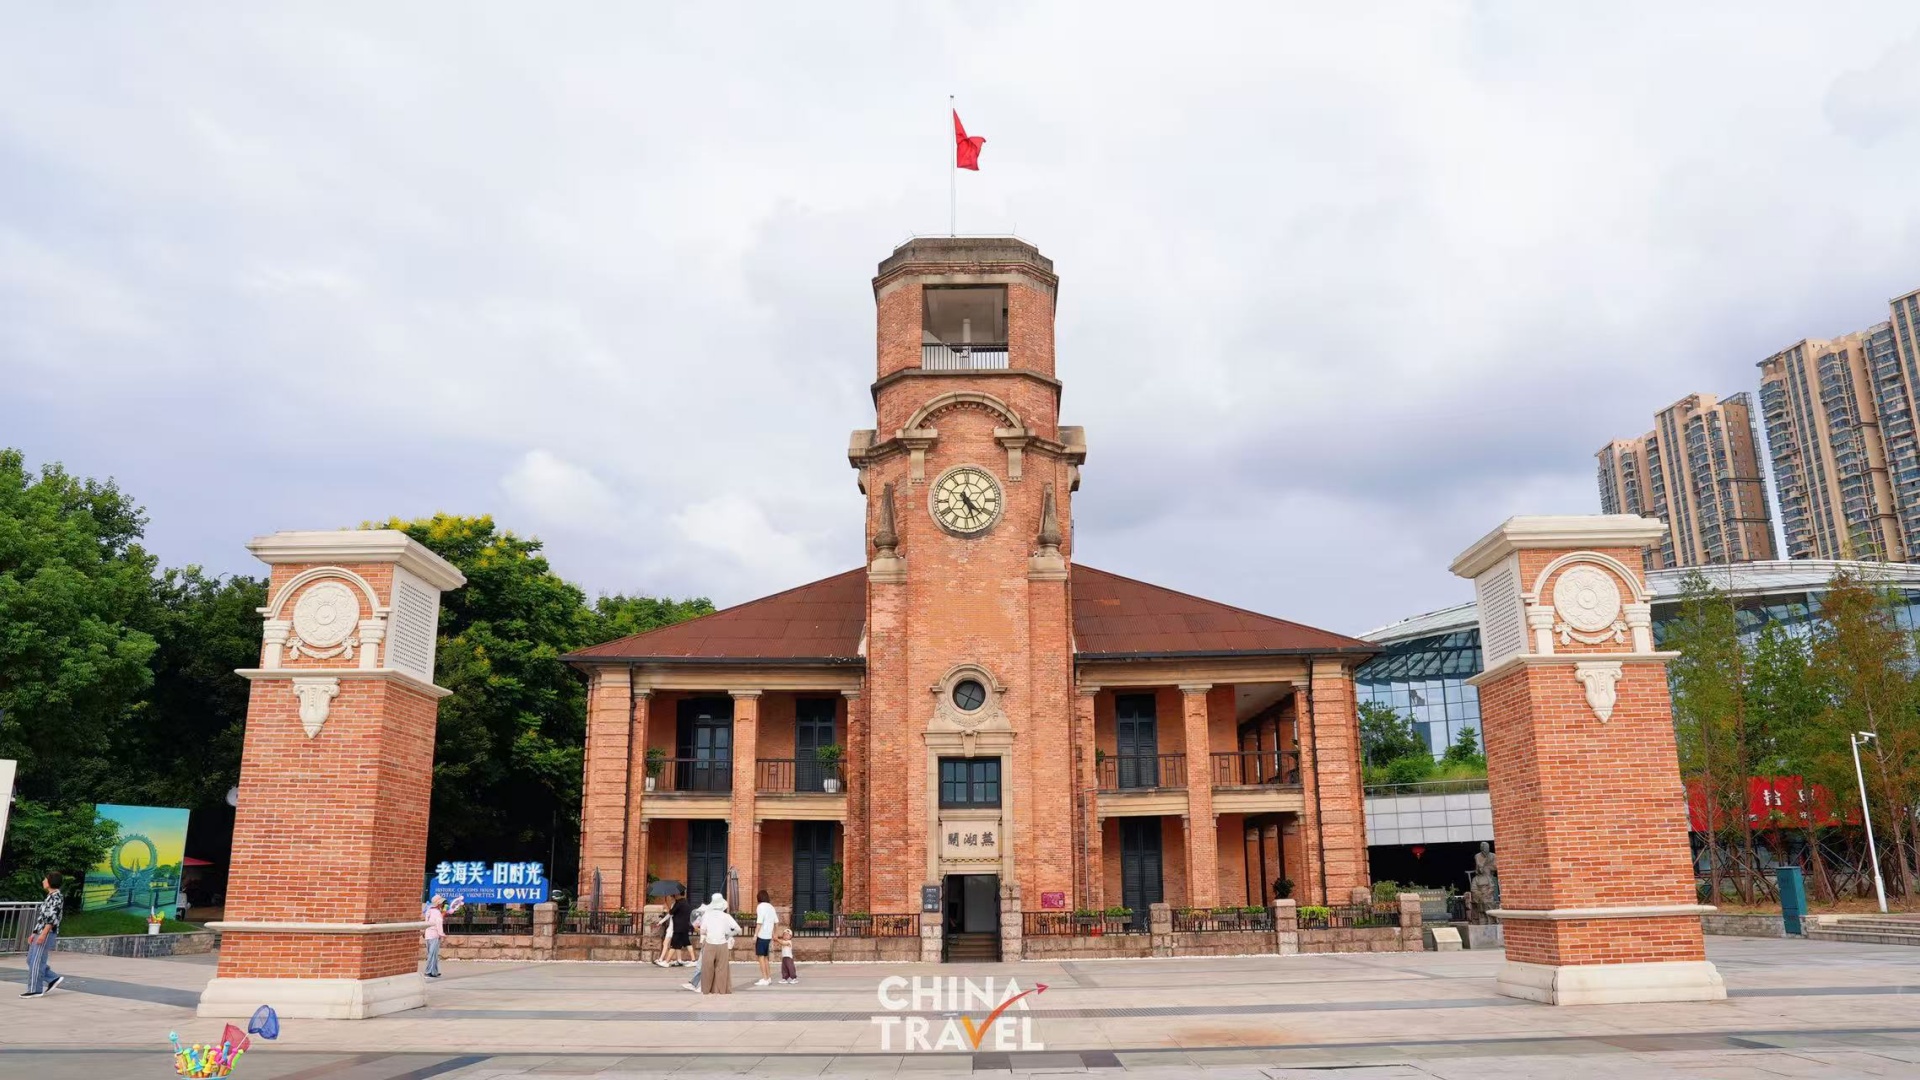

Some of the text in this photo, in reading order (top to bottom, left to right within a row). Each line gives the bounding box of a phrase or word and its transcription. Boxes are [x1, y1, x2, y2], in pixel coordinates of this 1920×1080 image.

[435, 861, 543, 885] 老海关·旧时光
[496, 888, 541, 899] I WH
